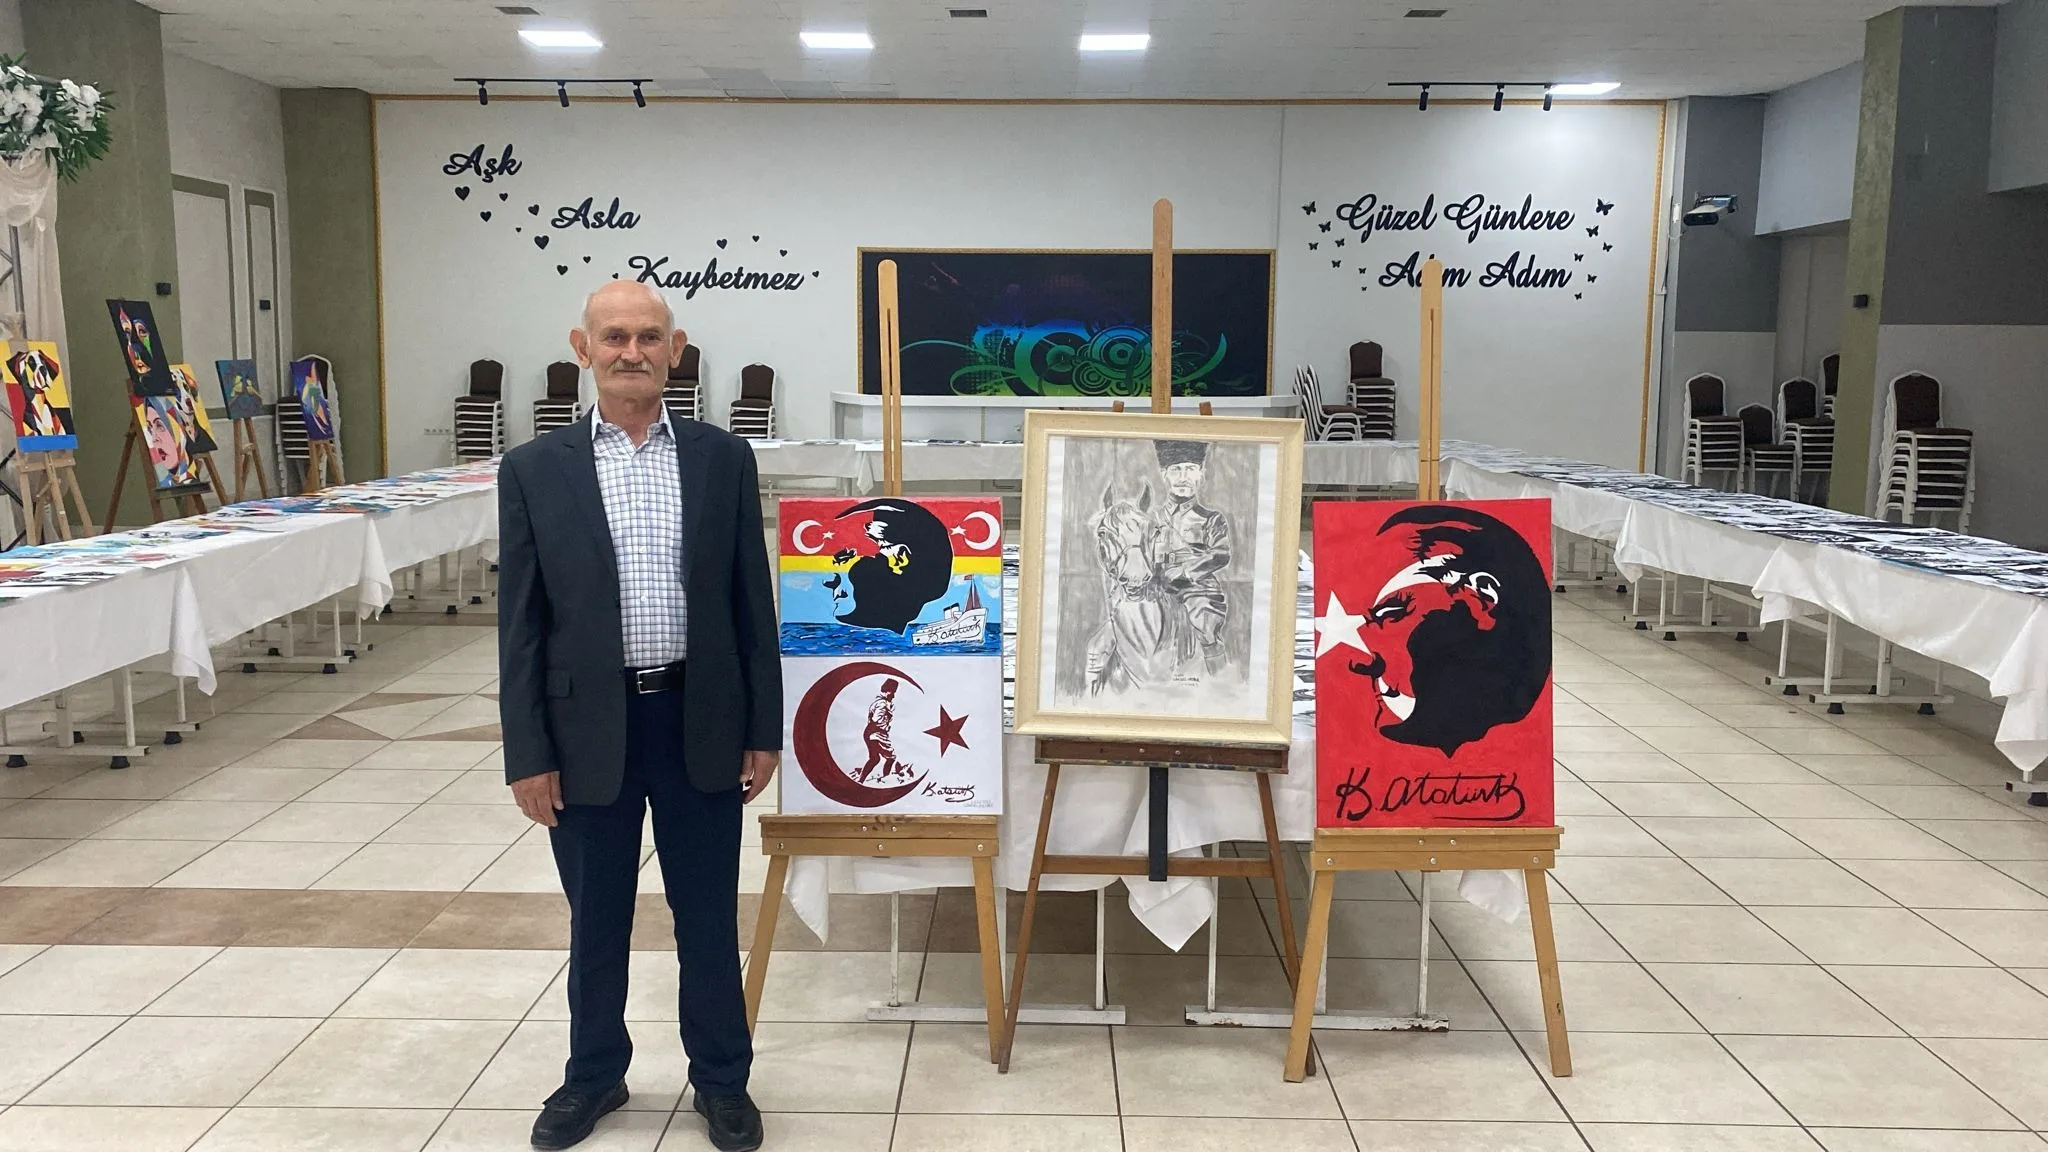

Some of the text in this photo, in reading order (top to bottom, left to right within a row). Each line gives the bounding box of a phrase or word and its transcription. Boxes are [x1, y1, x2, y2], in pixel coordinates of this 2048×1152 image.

[442, 143, 523, 184] Aşk
[550, 196, 641, 230] Asla
[1335, 193, 1576, 244] Güzel Günlere
[628, 255, 805, 300] Kaybetmez
[1478, 250, 1573, 288] Adım
